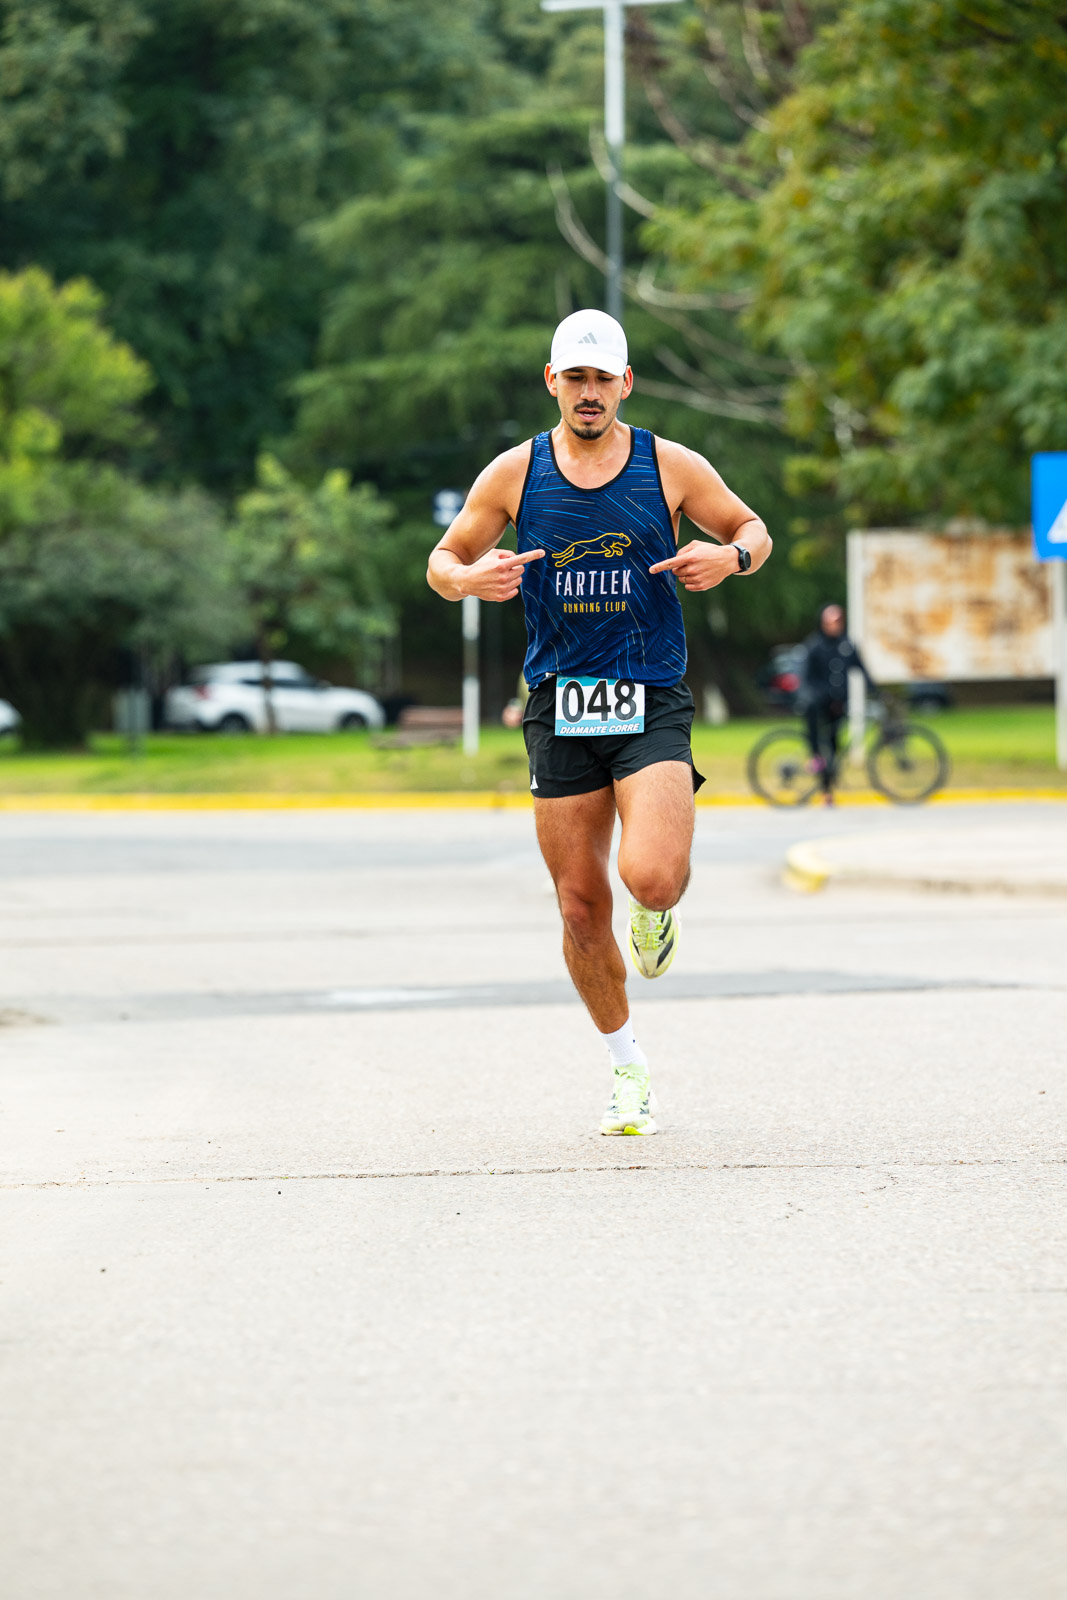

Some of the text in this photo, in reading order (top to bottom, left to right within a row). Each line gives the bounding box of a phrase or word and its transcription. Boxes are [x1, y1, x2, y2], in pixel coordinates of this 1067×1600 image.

[555, 569, 631, 596] FARTLEK
[563, 601, 626, 613] RUNNING CLUB
[562, 680, 637, 723] 048
[560, 723, 640, 734] DIAMANTE CORRE
